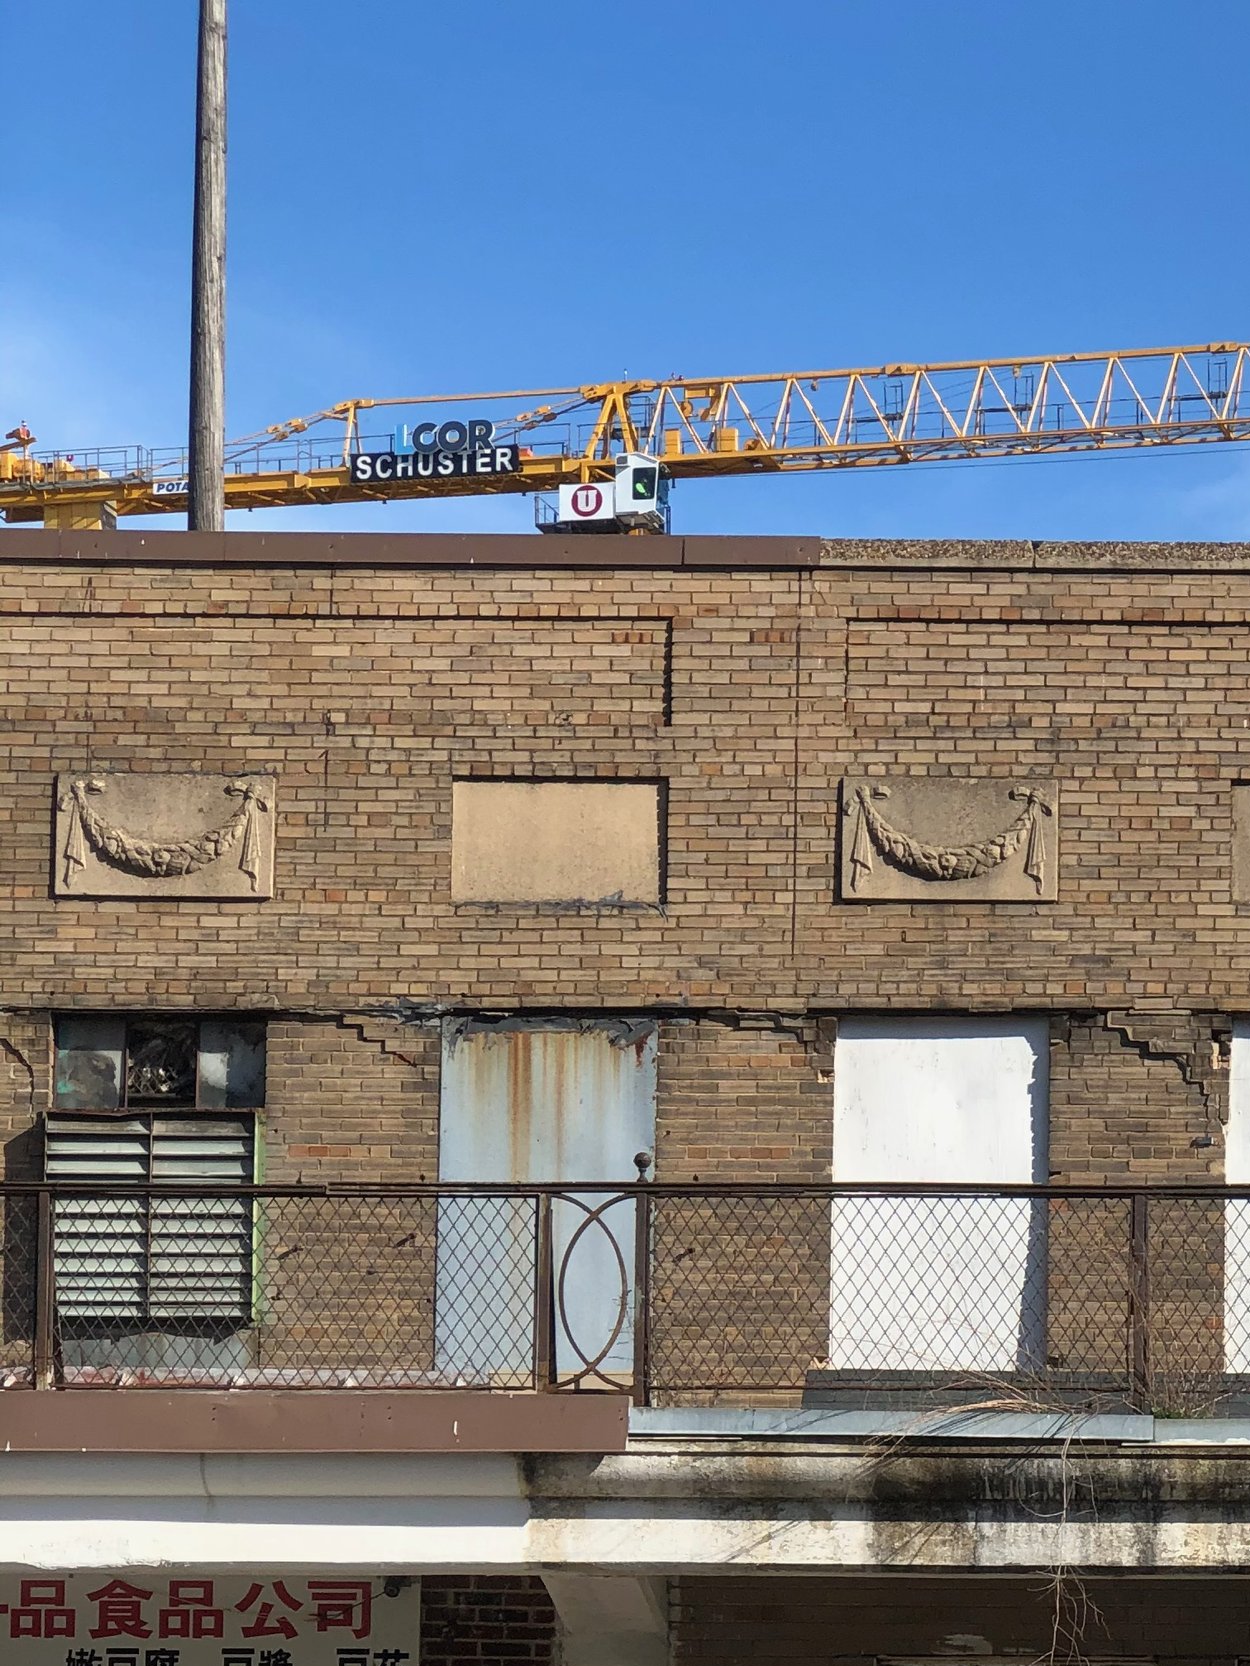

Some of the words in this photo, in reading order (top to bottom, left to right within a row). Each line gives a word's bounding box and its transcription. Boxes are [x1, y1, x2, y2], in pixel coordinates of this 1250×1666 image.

[356, 447, 513, 480] SCHUSTER
[0, 1580, 372, 1640] 品食品公司
